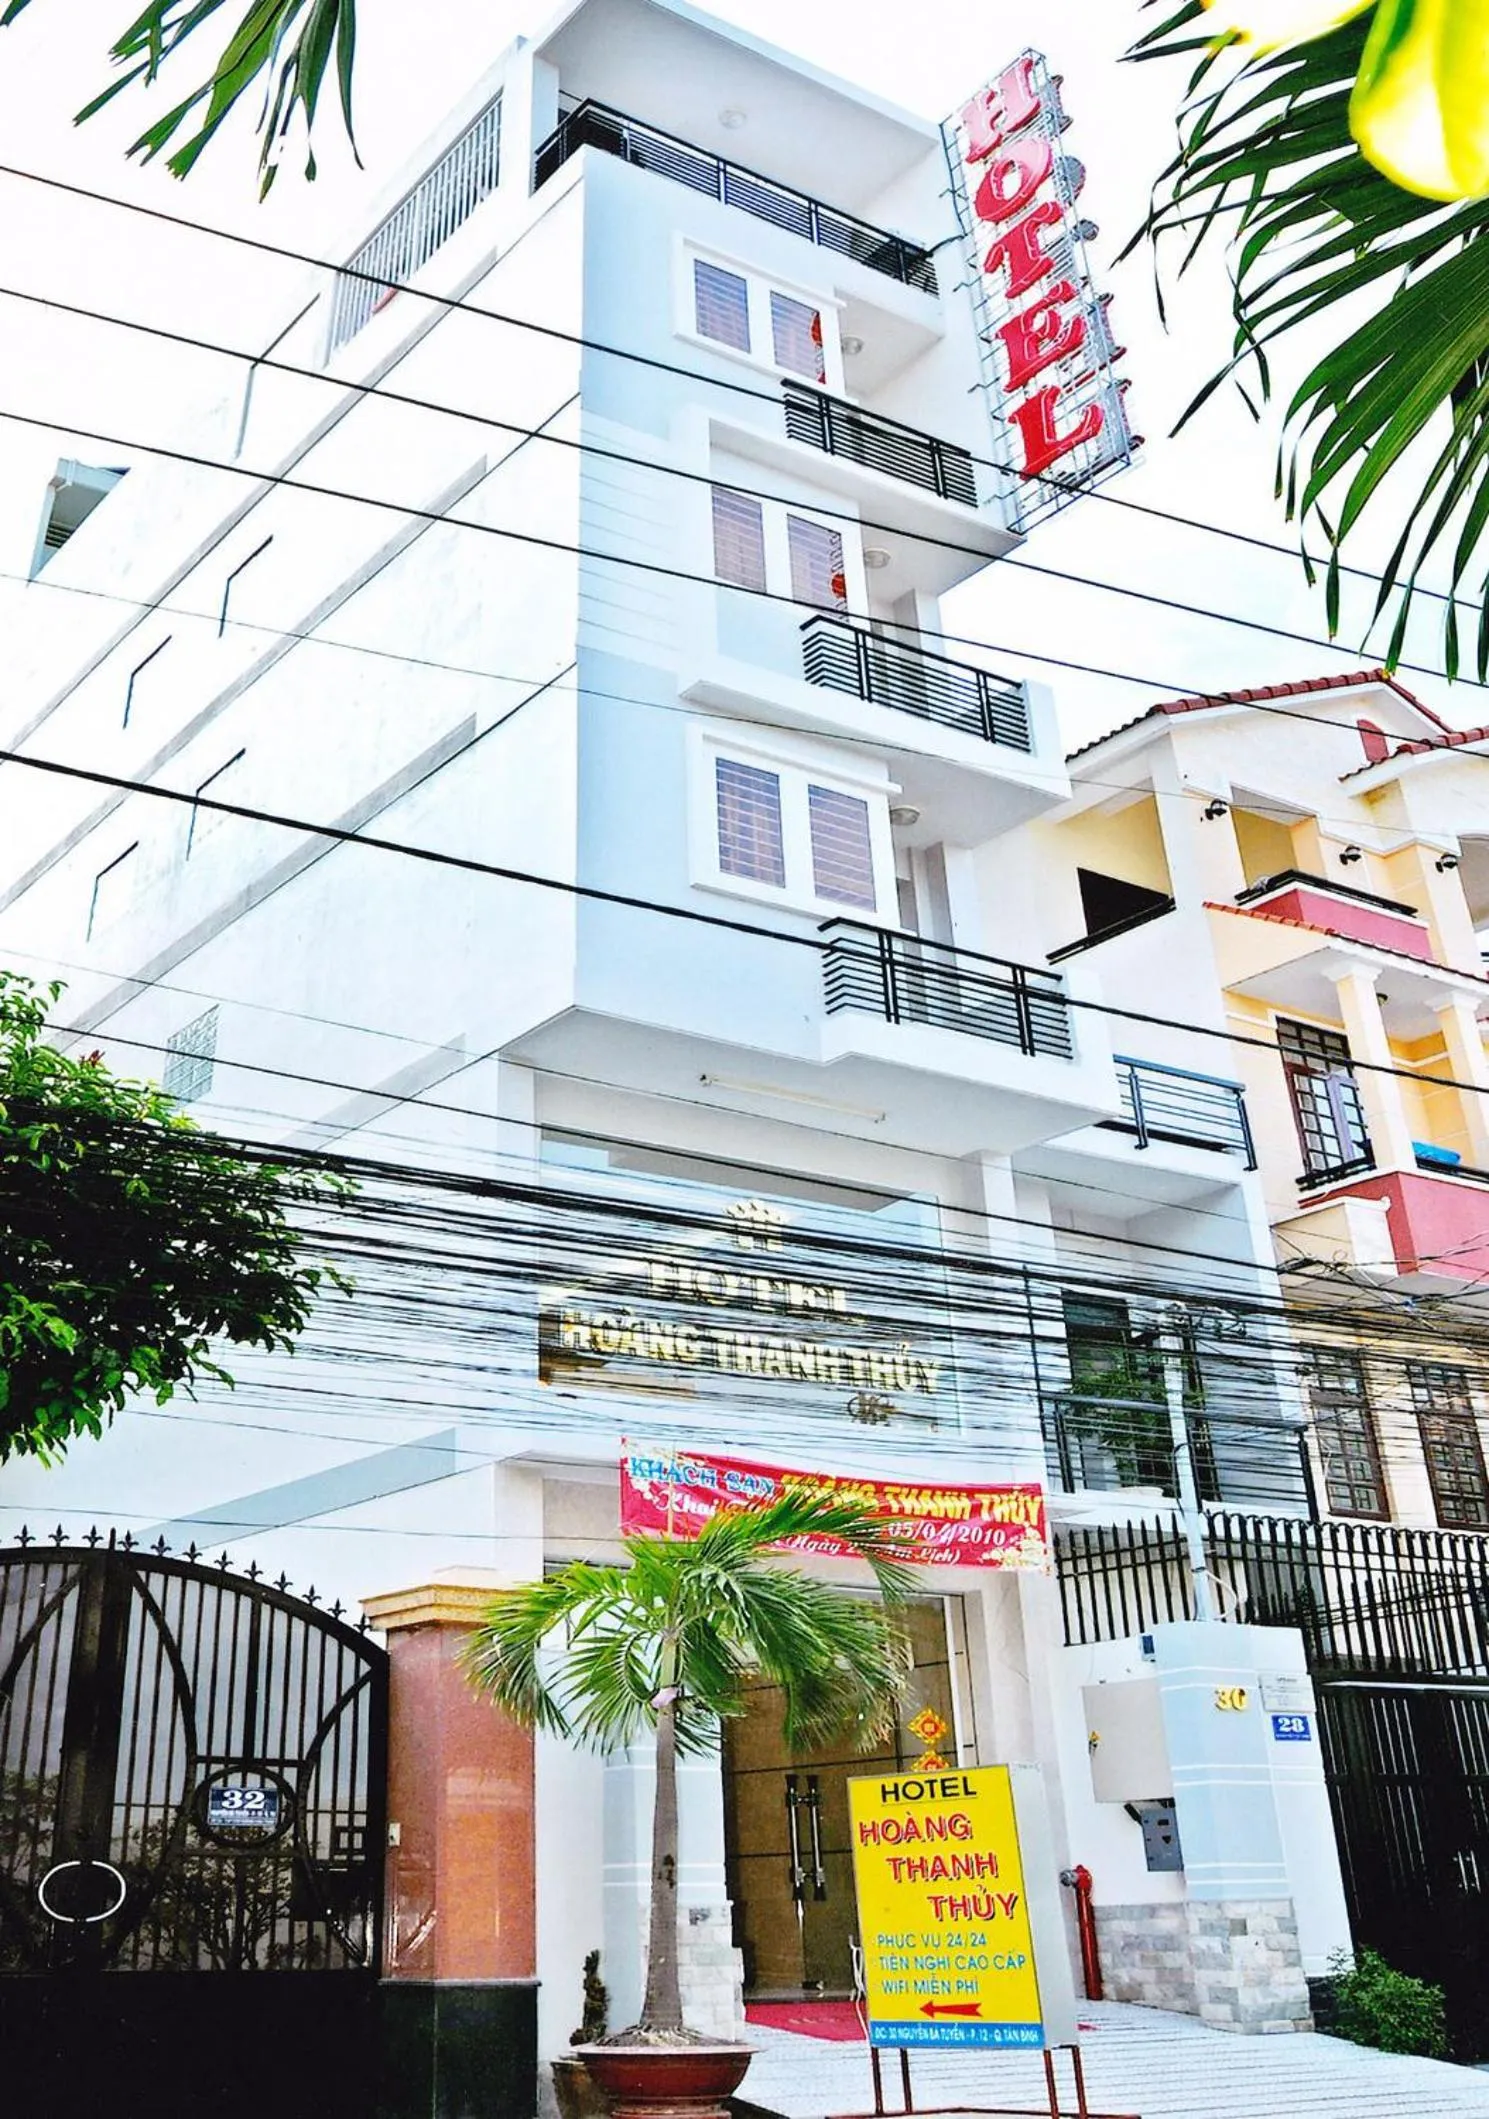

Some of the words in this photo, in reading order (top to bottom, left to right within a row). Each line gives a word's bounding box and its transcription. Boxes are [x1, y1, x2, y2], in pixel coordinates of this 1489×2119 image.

[960, 57, 1106, 482] HOTEL
[883, 1486, 972, 1521] THANH
[221, 1789, 266, 1810] 32
[880, 1775, 977, 1803] HOTEL
[858, 1811, 974, 1847] HOÀNG
[885, 1852, 1000, 1884] THANH
[927, 1884, 1018, 1922] THỦY
[955, 1954, 989, 1970] CAO
[881, 1979, 909, 1995] WIFI
